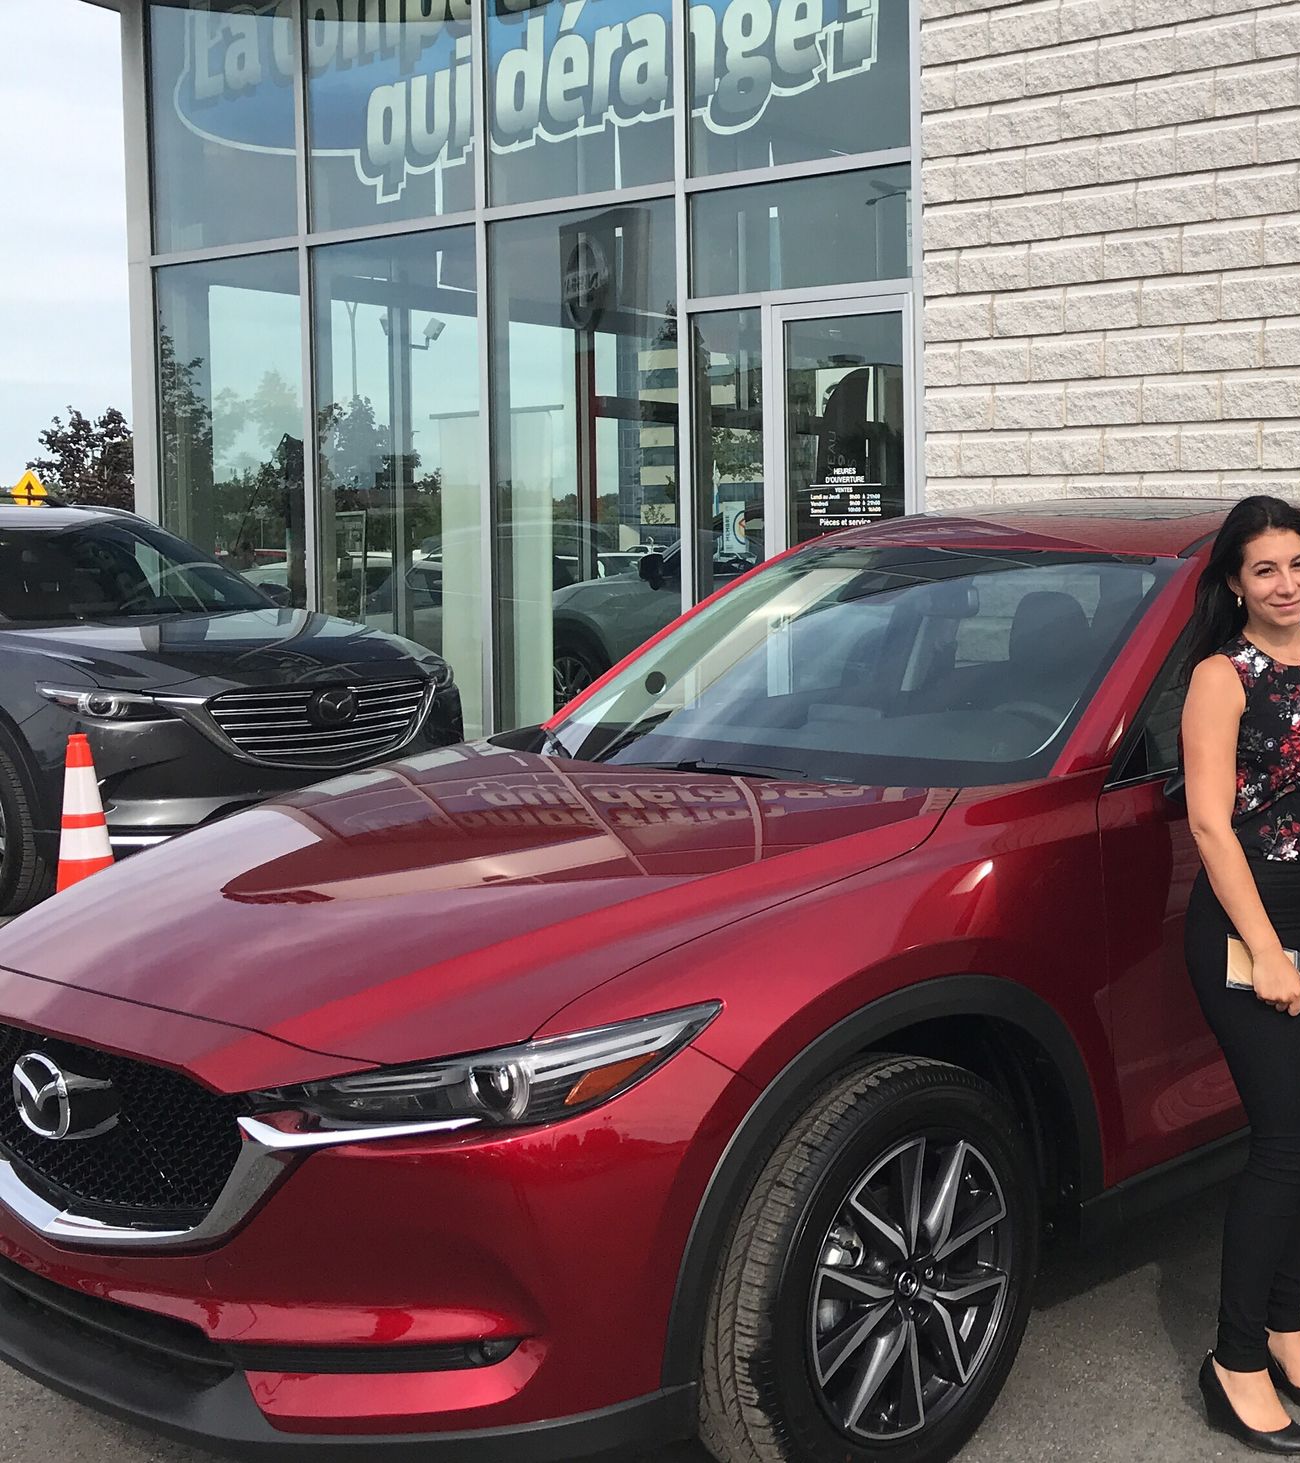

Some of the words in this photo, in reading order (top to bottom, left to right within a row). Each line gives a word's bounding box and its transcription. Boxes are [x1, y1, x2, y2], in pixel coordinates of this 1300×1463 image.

[367, 35, 471, 181] qui
[833, 467, 857, 475] HEURES
[825, 475, 865, 484] D'OUVERTURE
[819, 518, 840, 526] Pièces
[841, 518, 848, 526] et
[848, 517, 871, 526] service
